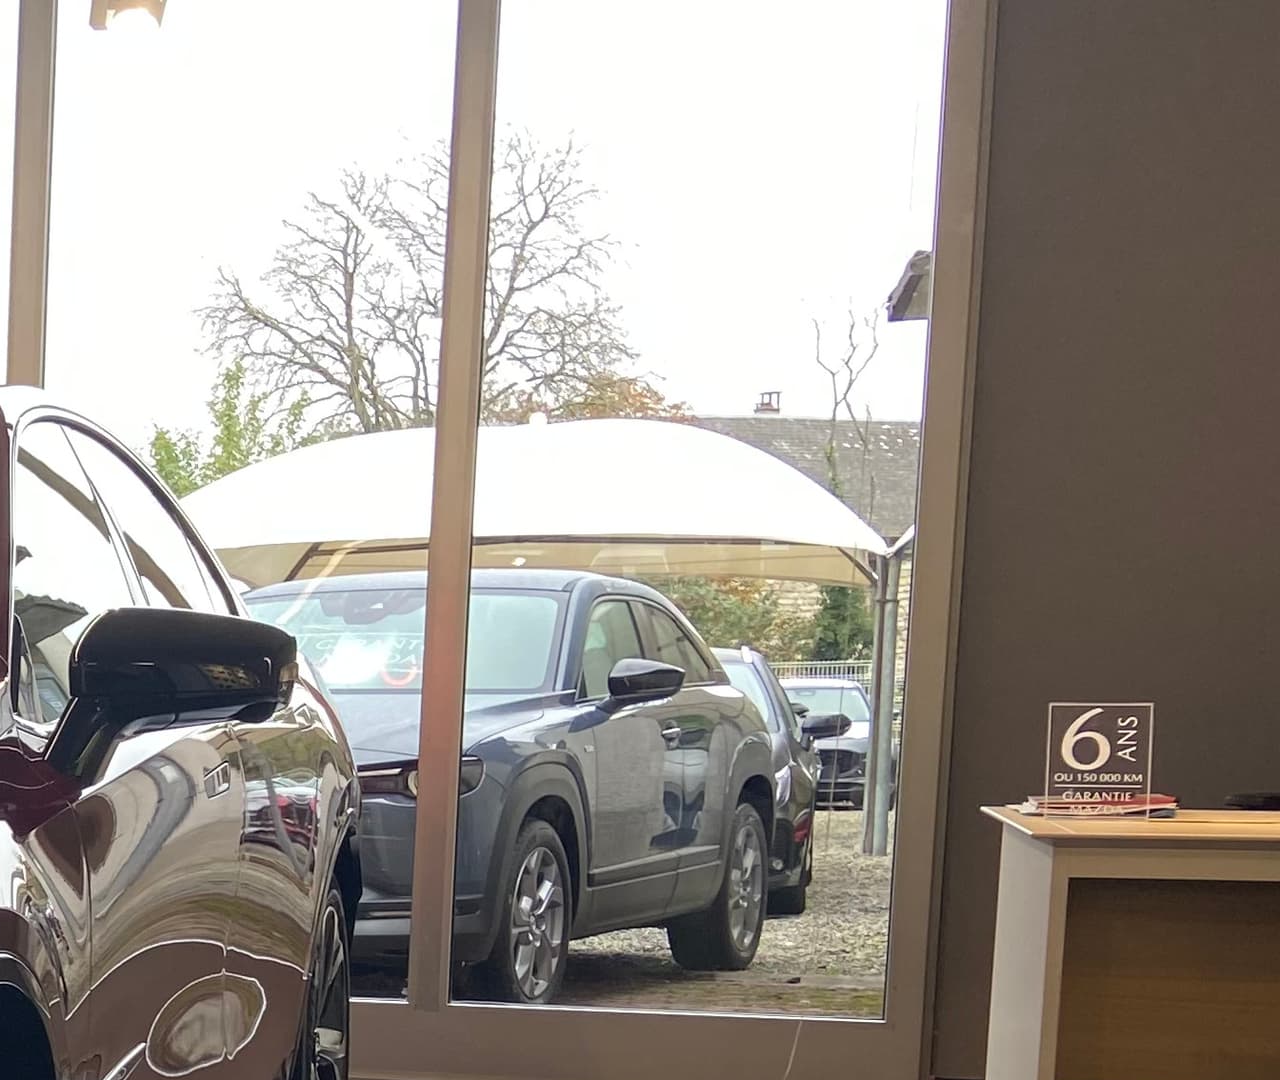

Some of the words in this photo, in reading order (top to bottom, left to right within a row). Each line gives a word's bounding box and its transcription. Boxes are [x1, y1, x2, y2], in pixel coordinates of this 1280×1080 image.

[1061, 707, 1112, 771] 6
[1117, 716, 1139, 762] ANS
[1054, 772, 1073, 782] OU
[1077, 773, 1097, 783] 150
[1100, 773, 1121, 783] 000
[1124, 773, 1143, 783] KM
[1062, 791, 1134, 802] GARANTIE
